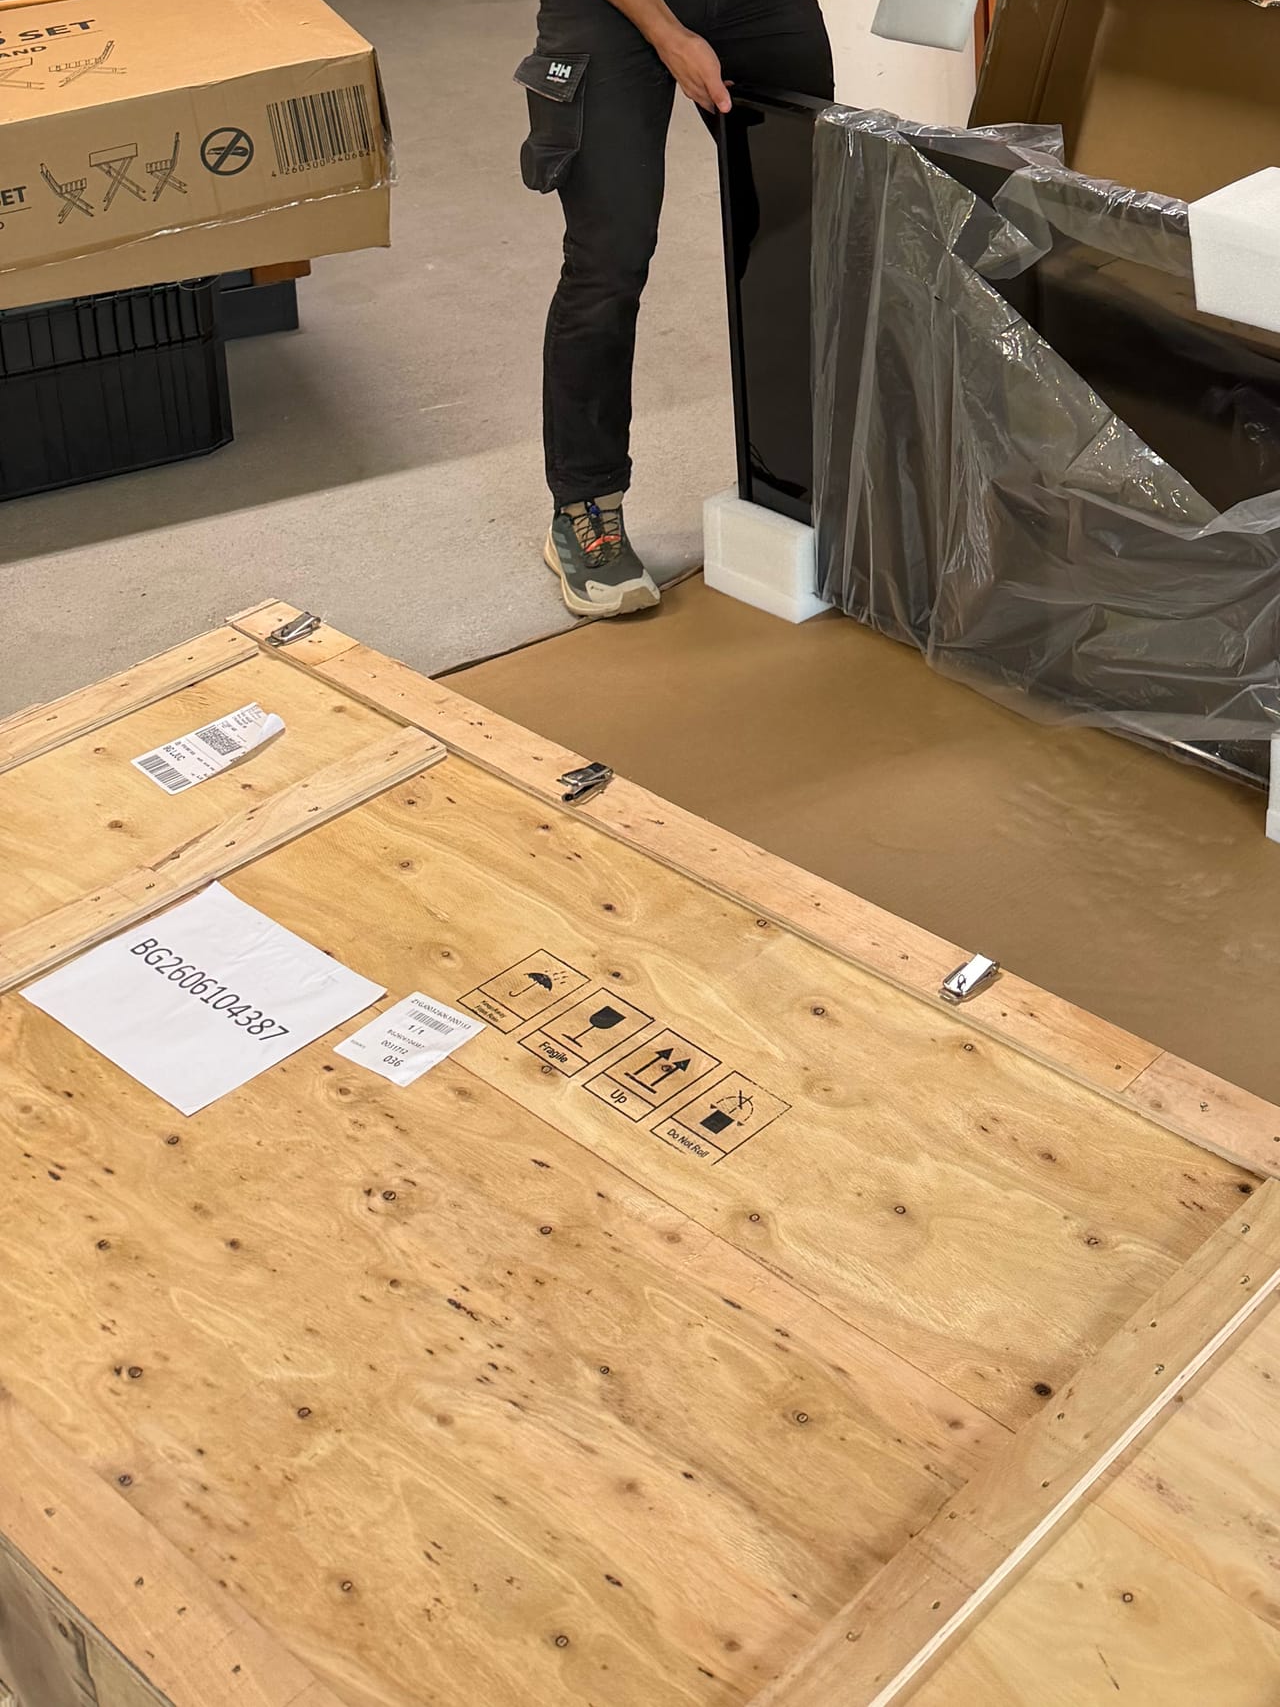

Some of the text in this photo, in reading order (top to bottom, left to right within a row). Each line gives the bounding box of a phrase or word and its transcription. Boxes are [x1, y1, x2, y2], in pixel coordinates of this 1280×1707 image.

[18, 19, 96, 41] SET
[0, 185, 27, 206] ET
[130, 937, 290, 1042] BG2606104387
[383, 1054, 404, 1068] 036
[538, 1041, 569, 1064] Fragile
[610, 1088, 628, 1105] Up
[666, 1127, 709, 1159] Do Not Roll
